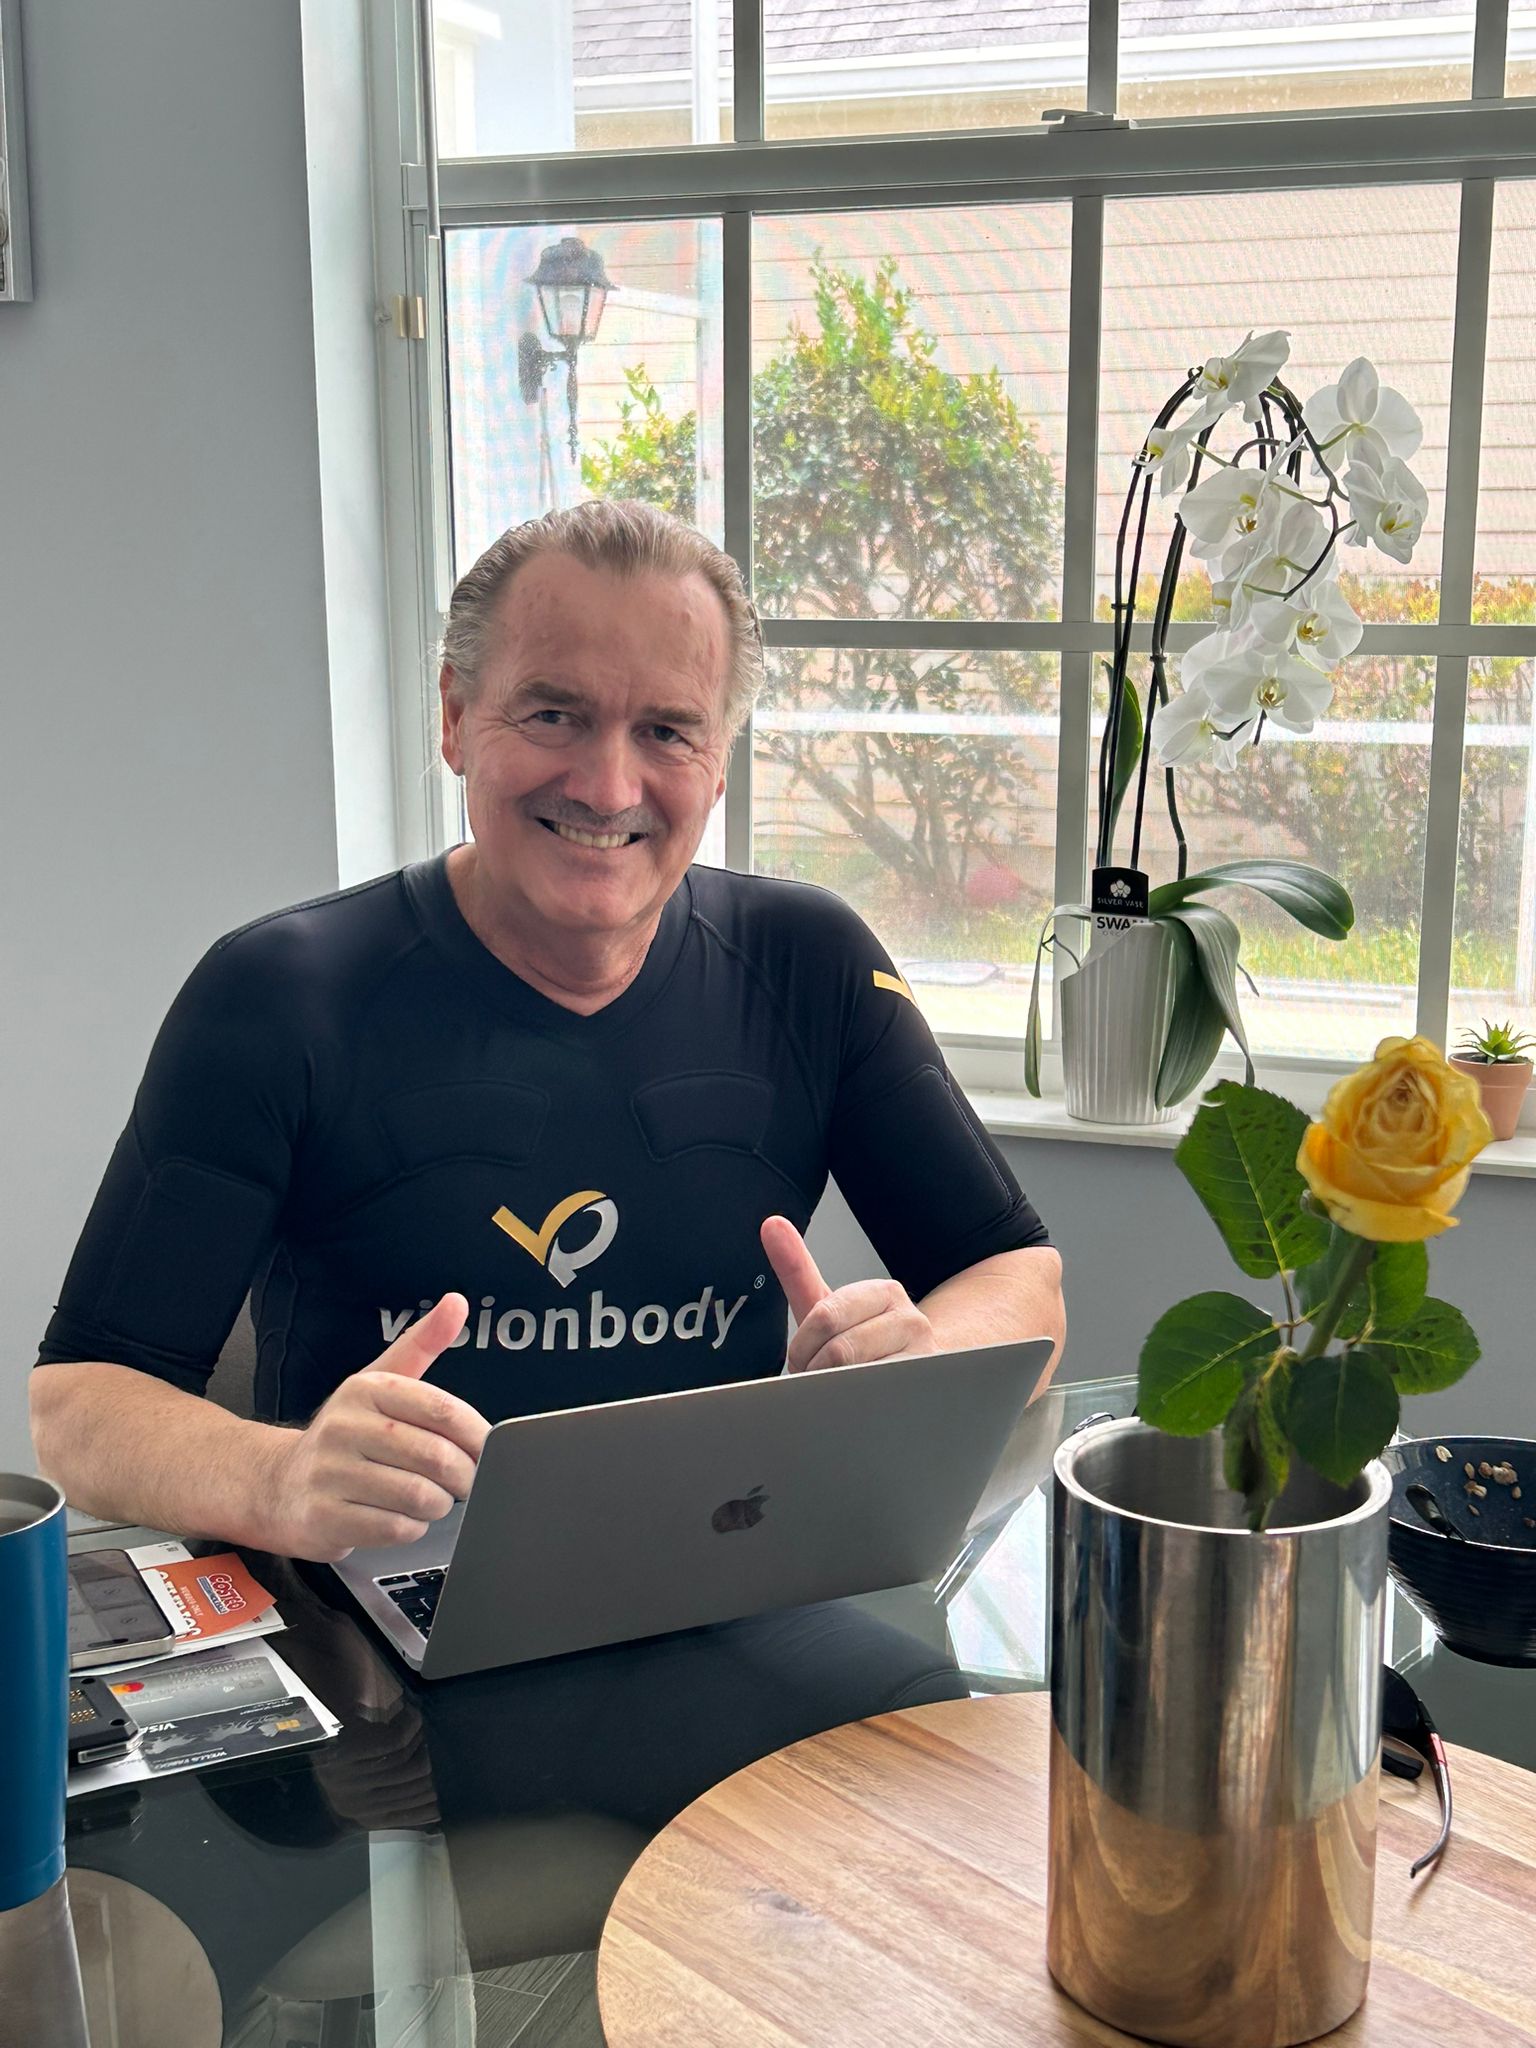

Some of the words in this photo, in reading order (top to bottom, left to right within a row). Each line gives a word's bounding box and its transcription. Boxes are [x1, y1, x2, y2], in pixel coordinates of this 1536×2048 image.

[1097, 897, 1123, 906] SILVER
[1125, 900, 1144, 909] VASE
[1097, 916, 1144, 930] SWA
[379, 1286, 748, 1351] vionbody
[208, 1573, 247, 1611] COSTCO
